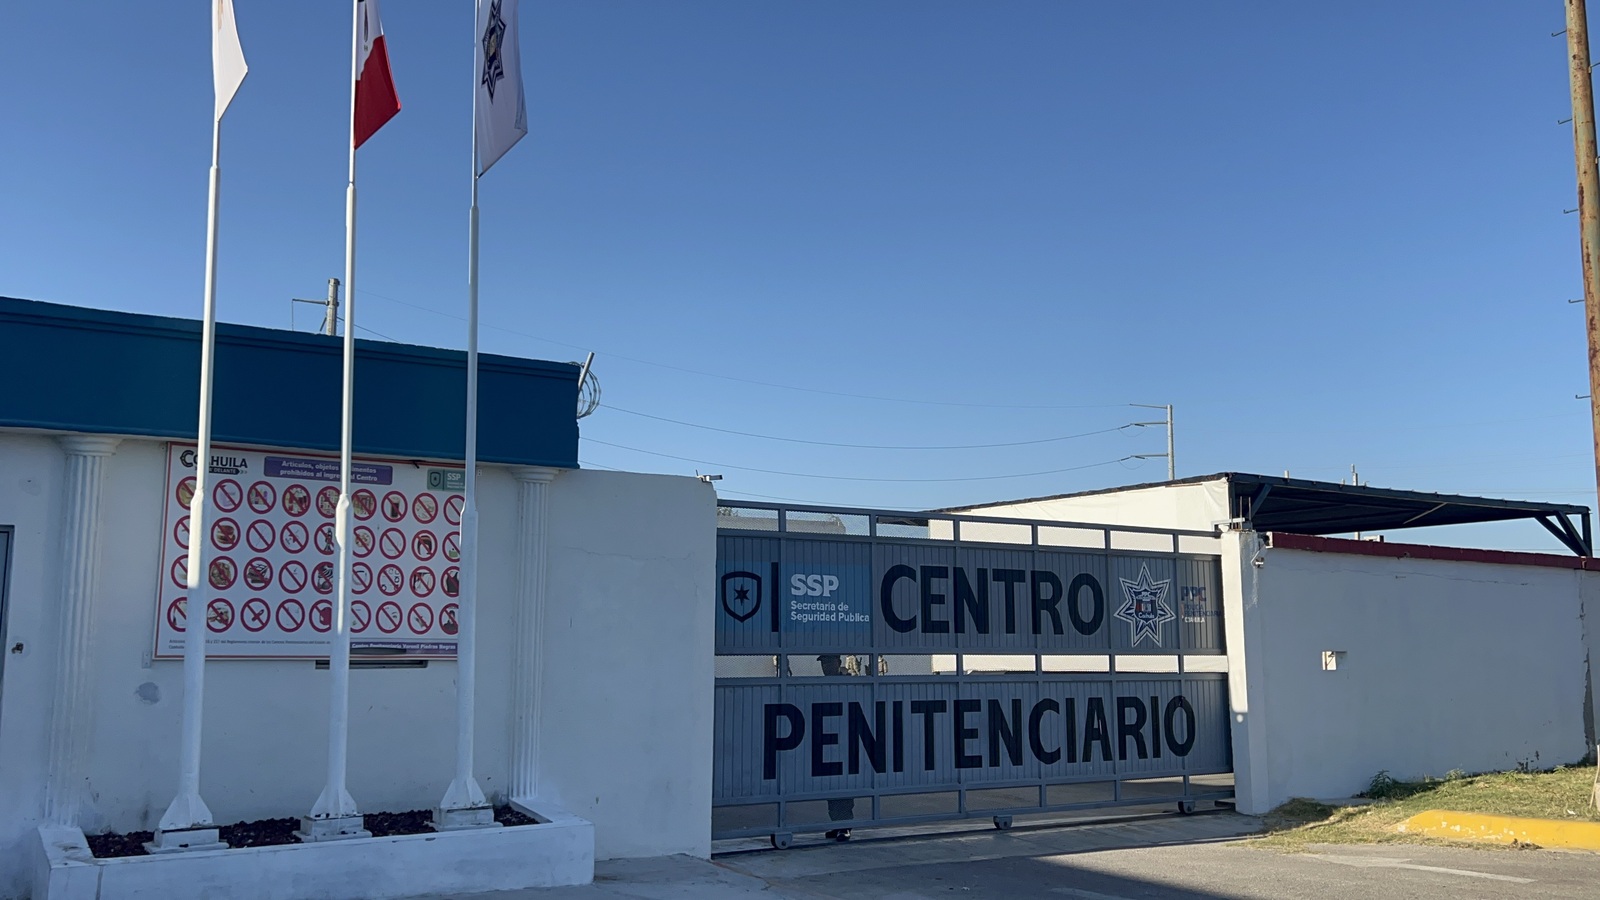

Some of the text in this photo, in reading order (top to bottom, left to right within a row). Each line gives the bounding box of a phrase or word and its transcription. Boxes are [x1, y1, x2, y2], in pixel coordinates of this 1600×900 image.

[180, 450, 248, 468] CHUILA
[280, 468, 315, 477] prohibidos
[316, 470, 322, 478] al
[323, 471, 340, 480] ingre
[356, 474, 378, 482] Centro
[315, 463, 339, 472] objetos
[351, 466, 377, 474] imentos
[447, 472, 461, 481] SSP
[790, 573, 839, 597] SSP
[880, 564, 1104, 636] CENTRO
[1181, 586, 1206, 602] PPC
[790, 600, 849, 611] Secretaría de
[790, 611, 836, 623] Seguridad
[763, 694, 1196, 780] PENITENCIARIO
